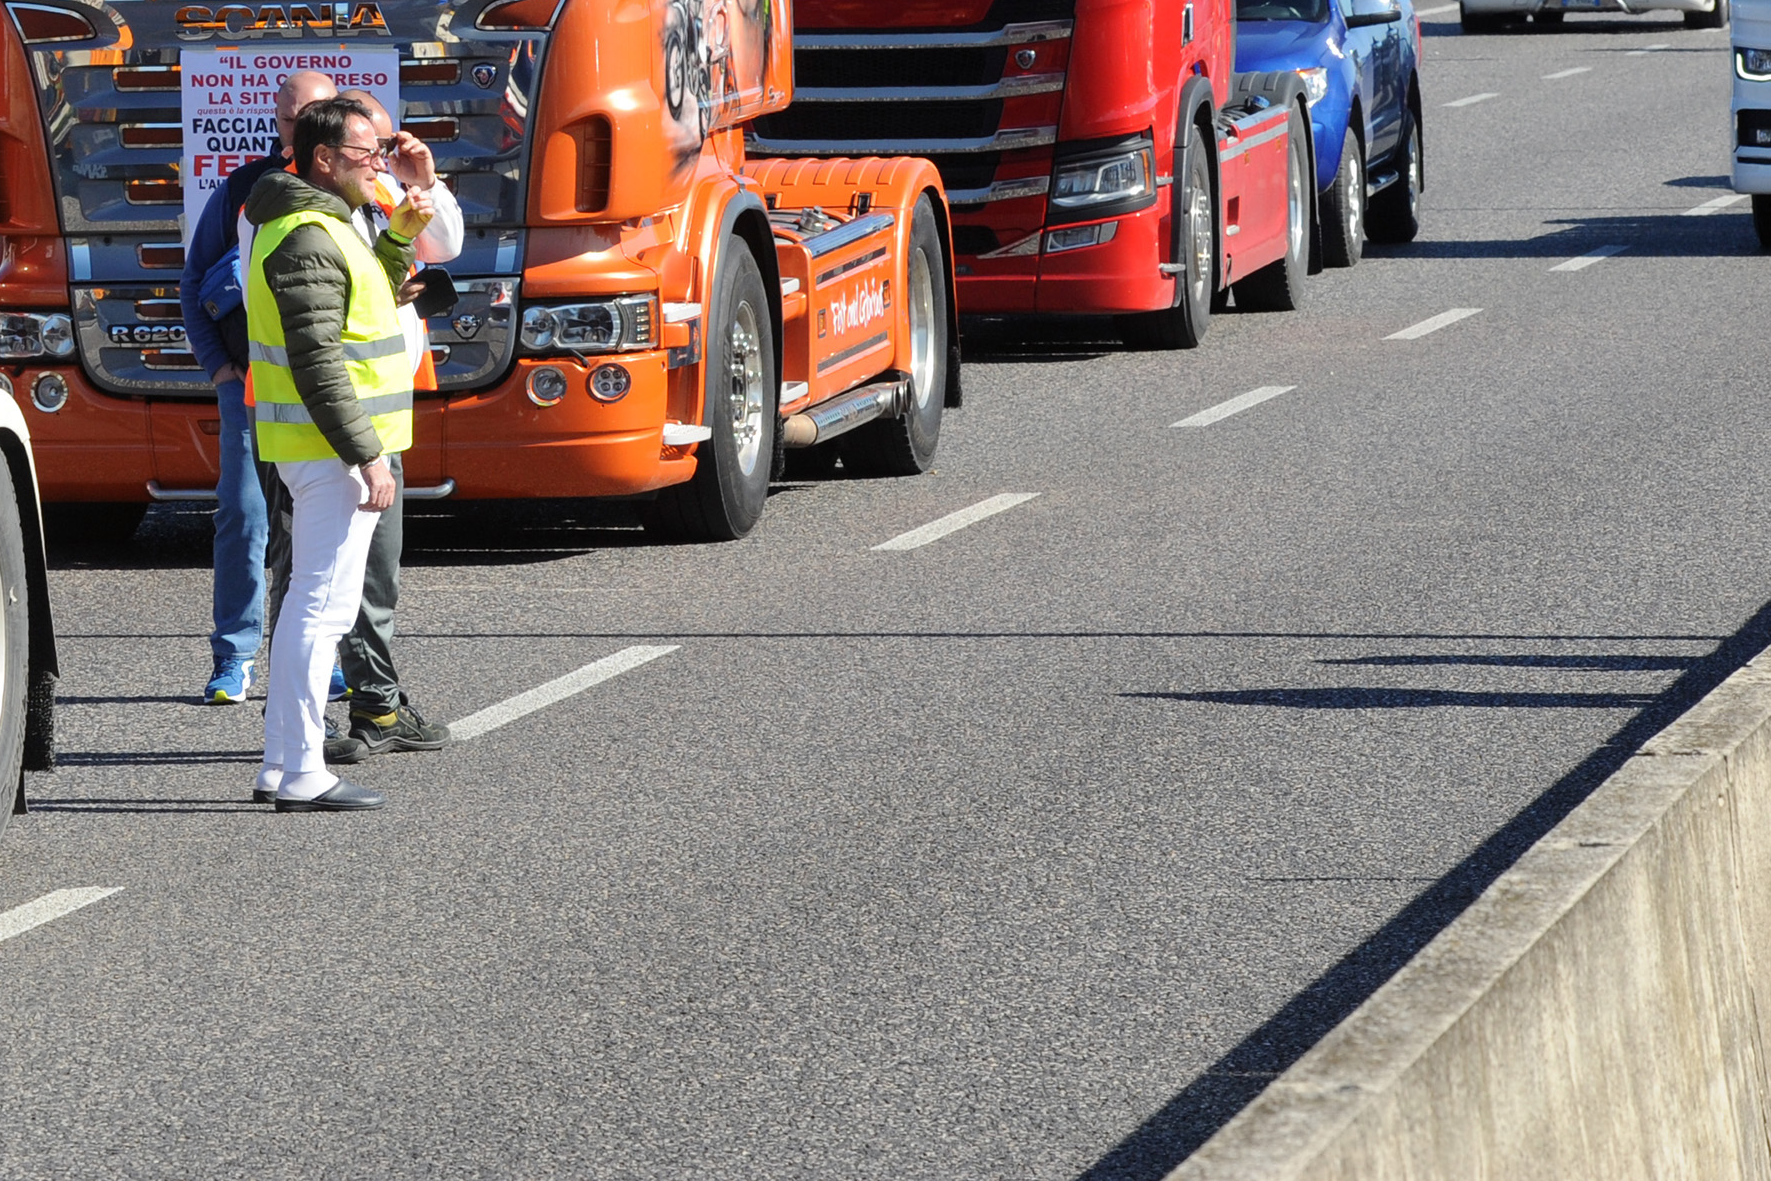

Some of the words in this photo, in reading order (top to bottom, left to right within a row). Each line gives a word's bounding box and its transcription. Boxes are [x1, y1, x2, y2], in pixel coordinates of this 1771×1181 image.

[174, 2, 392, 41] SCANIA
[254, 55, 352, 69] GOVERNO
[191, 74, 233, 87] NON
[242, 74, 270, 87] HA
[208, 92, 232, 105] LA
[197, 108, 227, 116] questa
[206, 136, 279, 153] QUANT
[111, 326, 128, 342] R
[133, 325, 186, 342] 620
